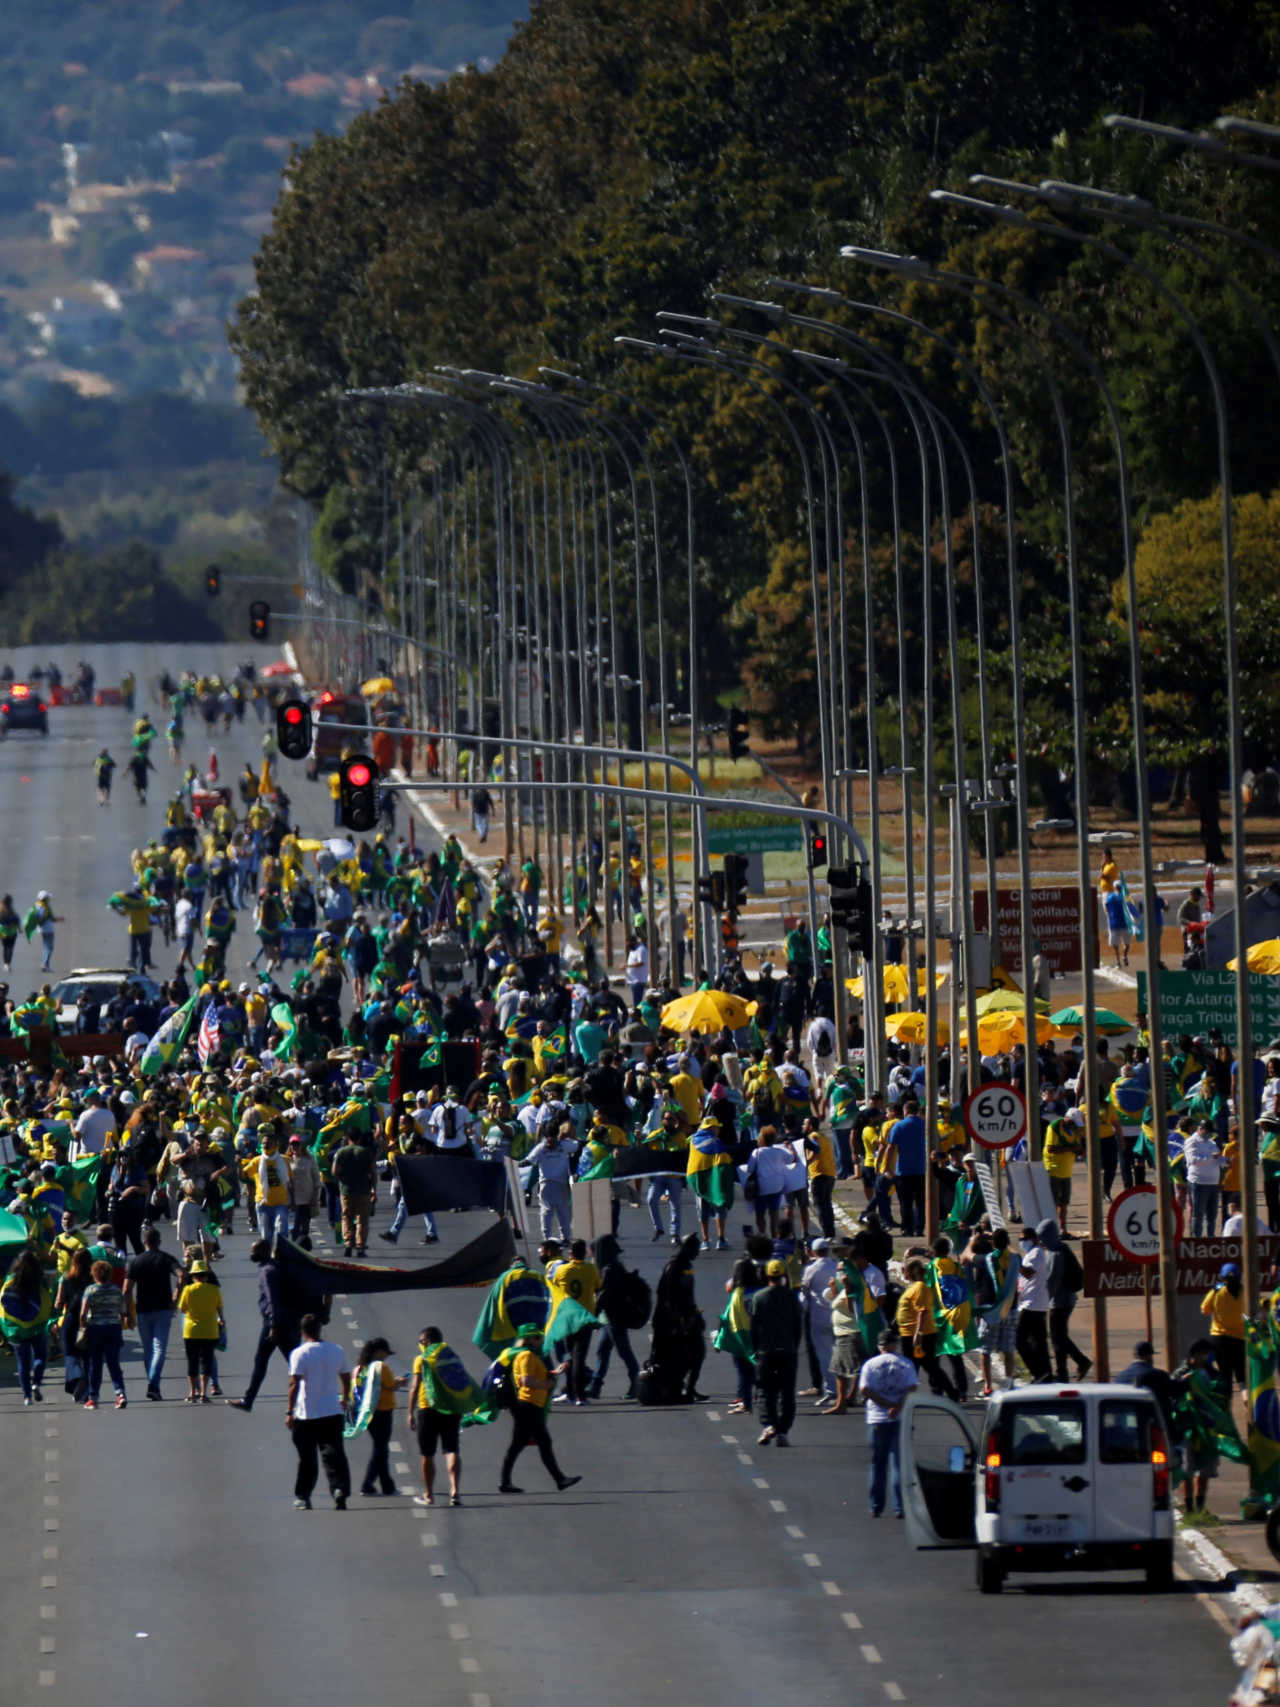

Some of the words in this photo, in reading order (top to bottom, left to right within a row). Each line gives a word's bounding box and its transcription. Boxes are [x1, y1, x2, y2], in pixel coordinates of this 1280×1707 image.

[1192, 972, 1214, 985] Via
[978, 1095, 1015, 1118] 60
[977, 1118, 1017, 1132] km/h
[1180, 1239, 1270, 1259] Nacioal
